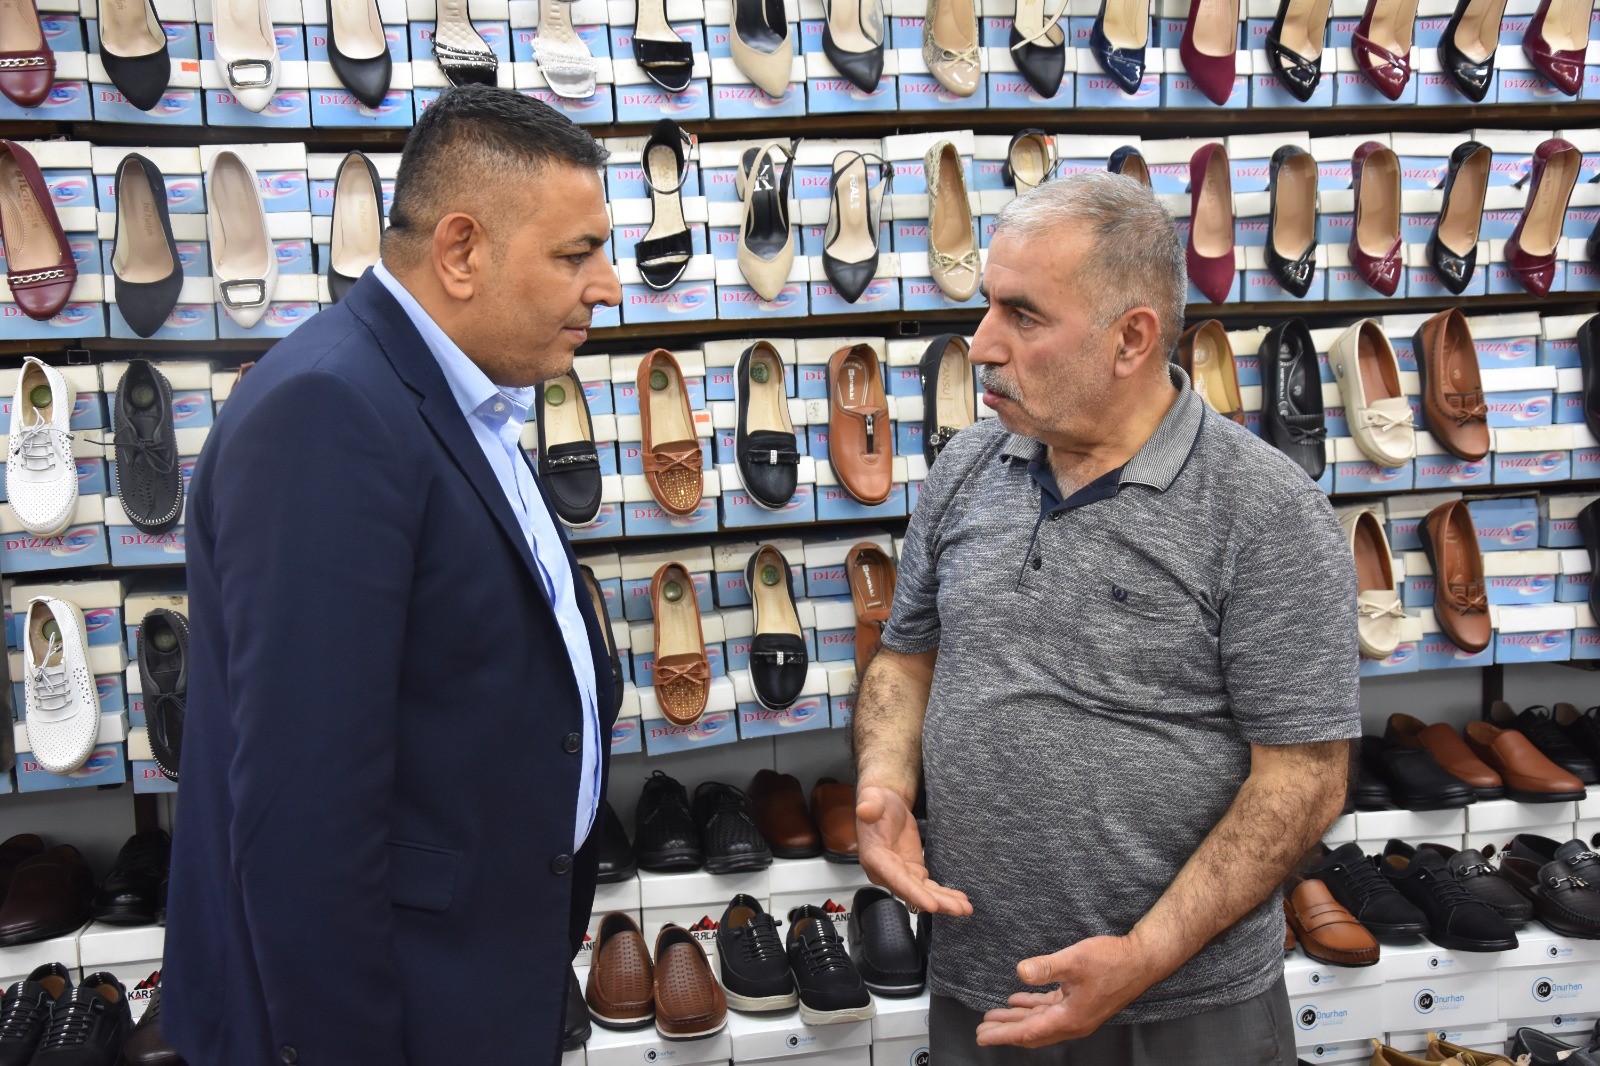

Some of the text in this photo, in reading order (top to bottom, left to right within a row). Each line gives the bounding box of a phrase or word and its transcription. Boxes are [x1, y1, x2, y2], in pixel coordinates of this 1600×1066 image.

[897, 164, 923, 175] DİZ
[900, 224, 926, 237] DİZ
[1552, 982, 1582, 991] Onurhan
[1434, 995, 1464, 1004] Onurhan
[1316, 1010, 1347, 1020] Onurhan
